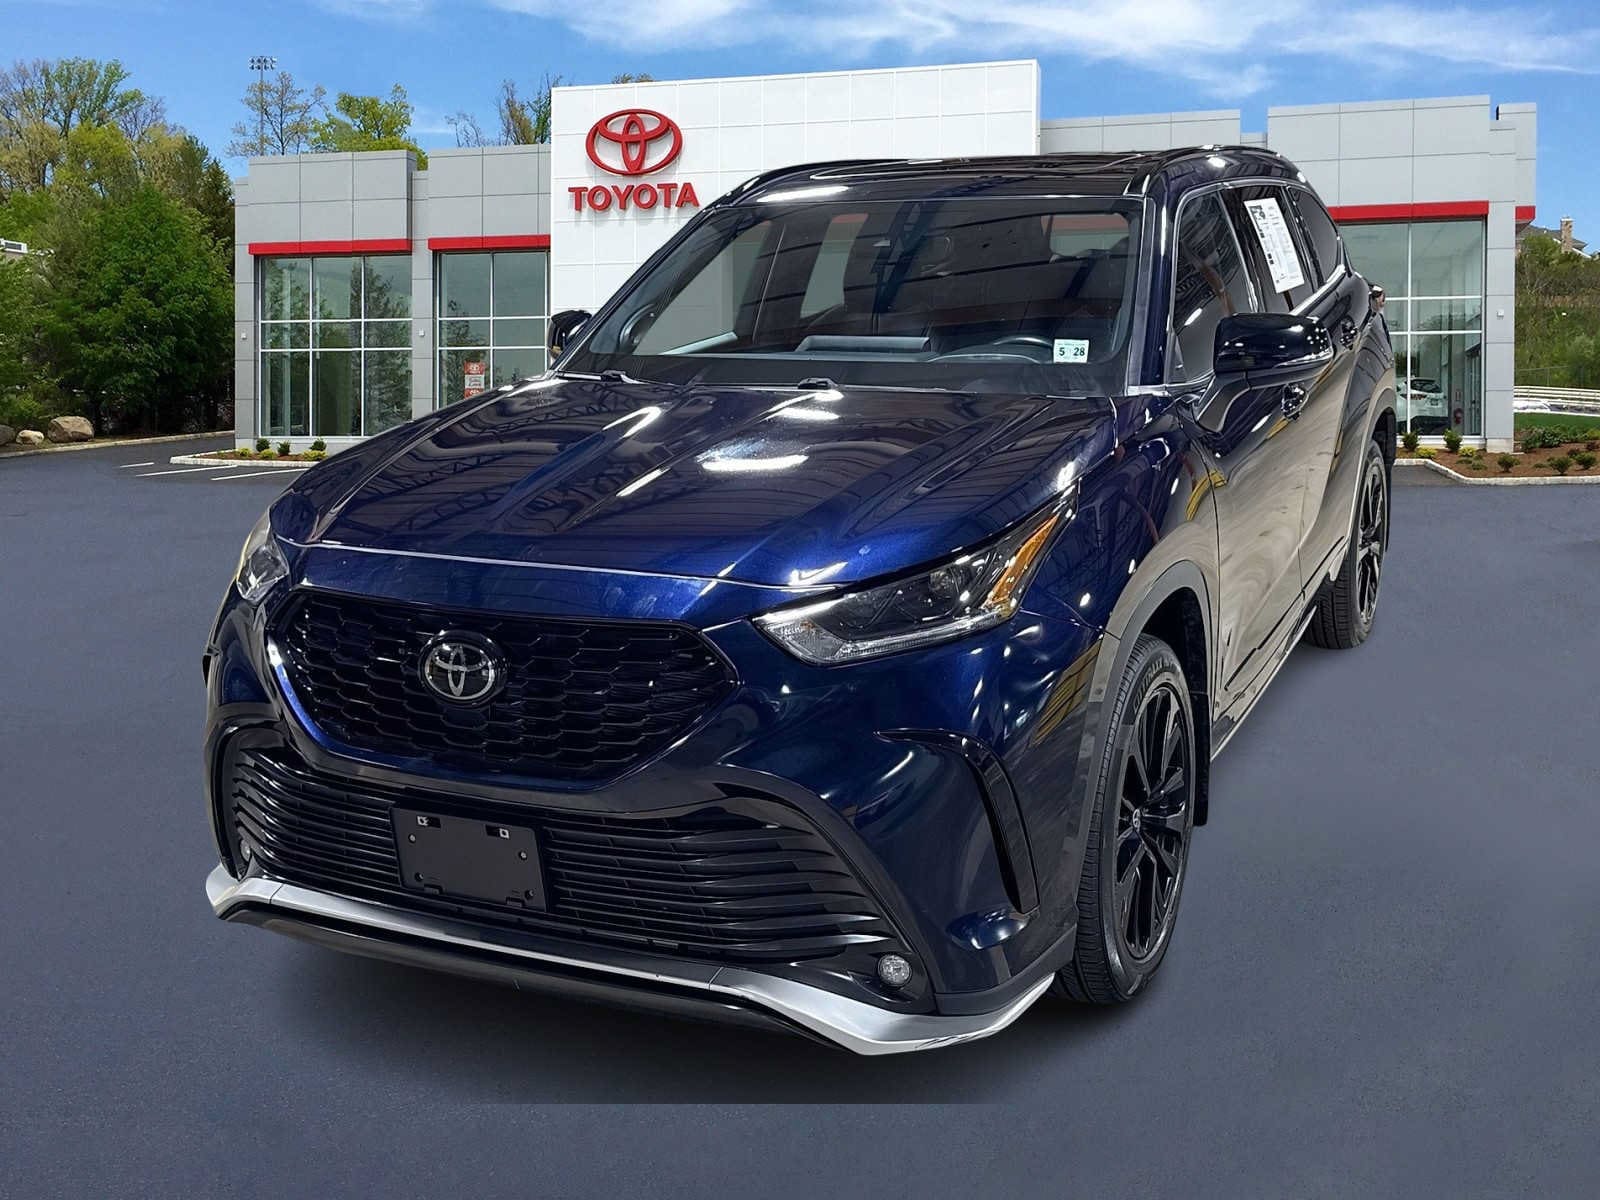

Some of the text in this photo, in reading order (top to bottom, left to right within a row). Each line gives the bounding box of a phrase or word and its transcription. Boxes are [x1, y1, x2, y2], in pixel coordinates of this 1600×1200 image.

[568, 182, 700, 211] TOYOTA
[1059, 347, 1085, 356] 5 28
